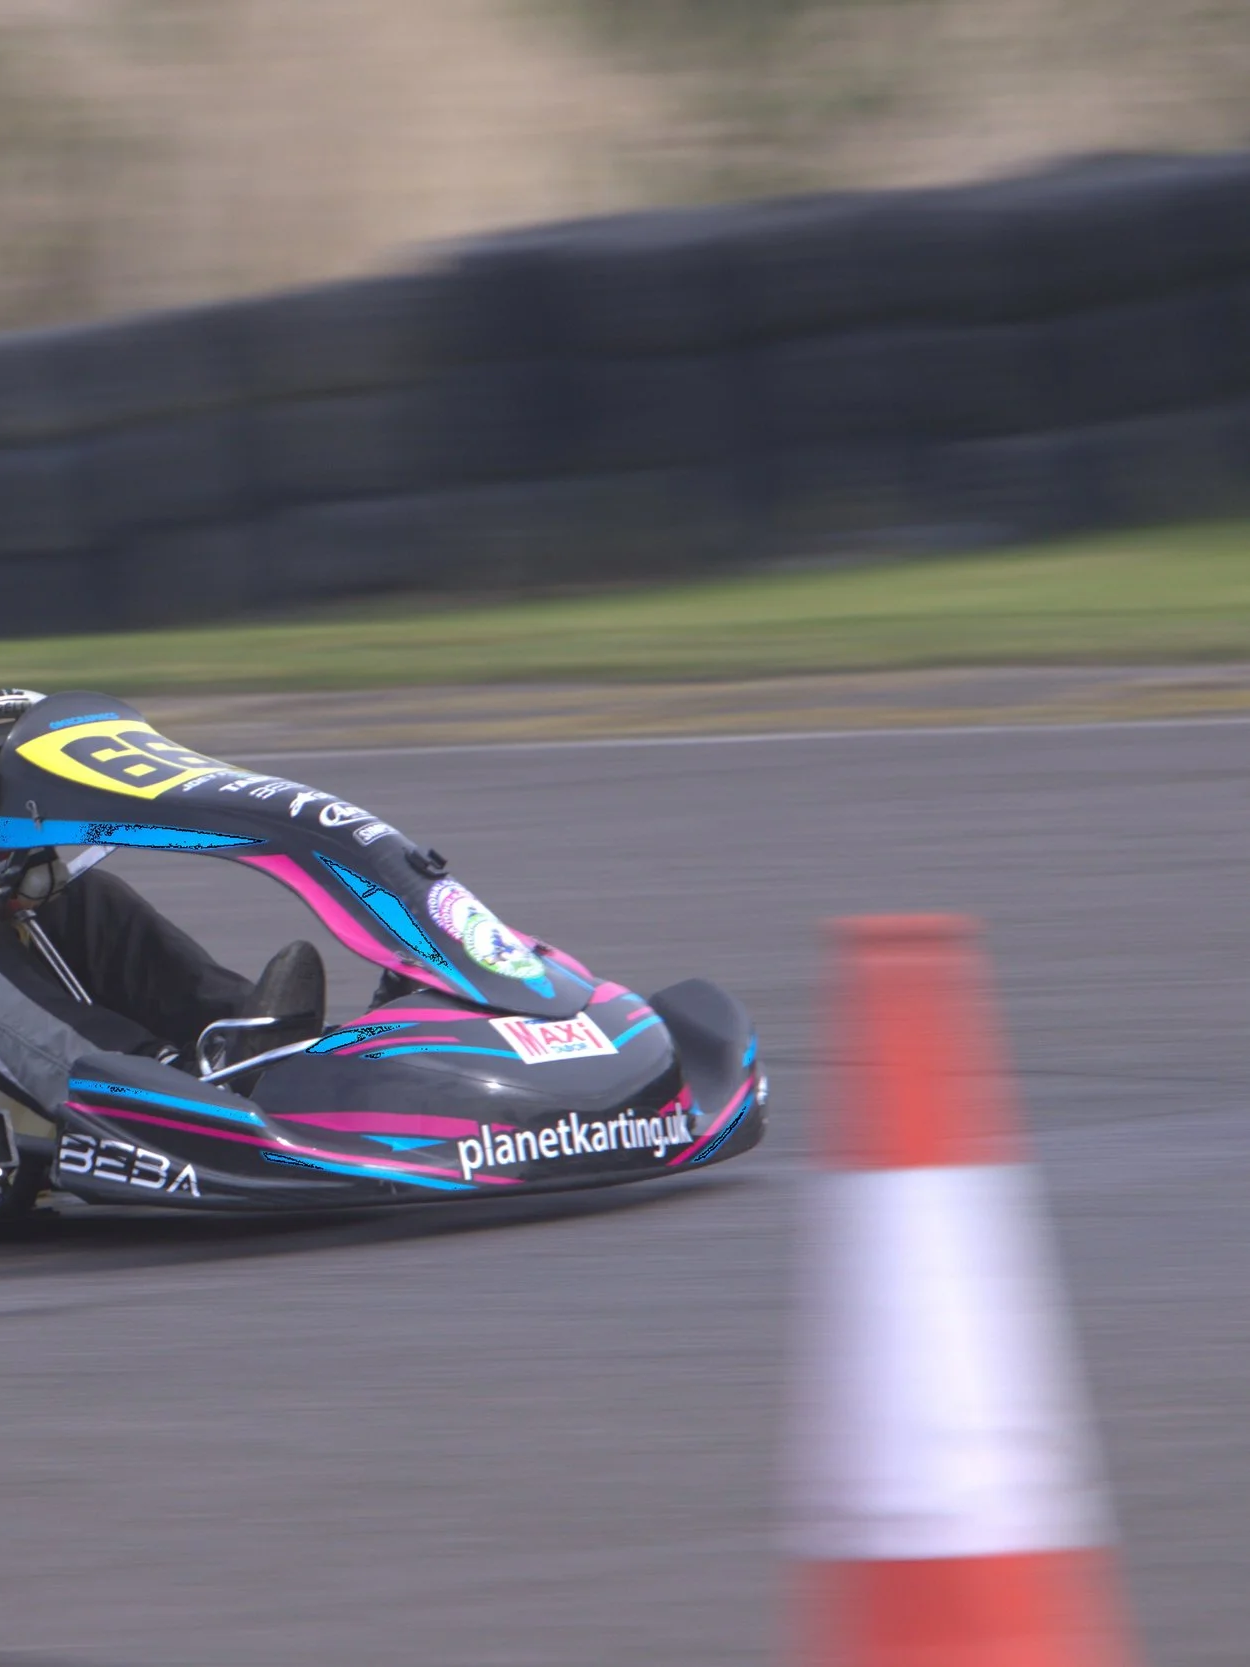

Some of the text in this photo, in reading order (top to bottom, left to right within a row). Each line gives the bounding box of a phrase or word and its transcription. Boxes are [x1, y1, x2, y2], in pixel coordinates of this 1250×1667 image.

[59, 730, 213, 789] 66
[58, 1132, 201, 1198] BEBA
[457, 1102, 694, 1181] planetkarting.uk
